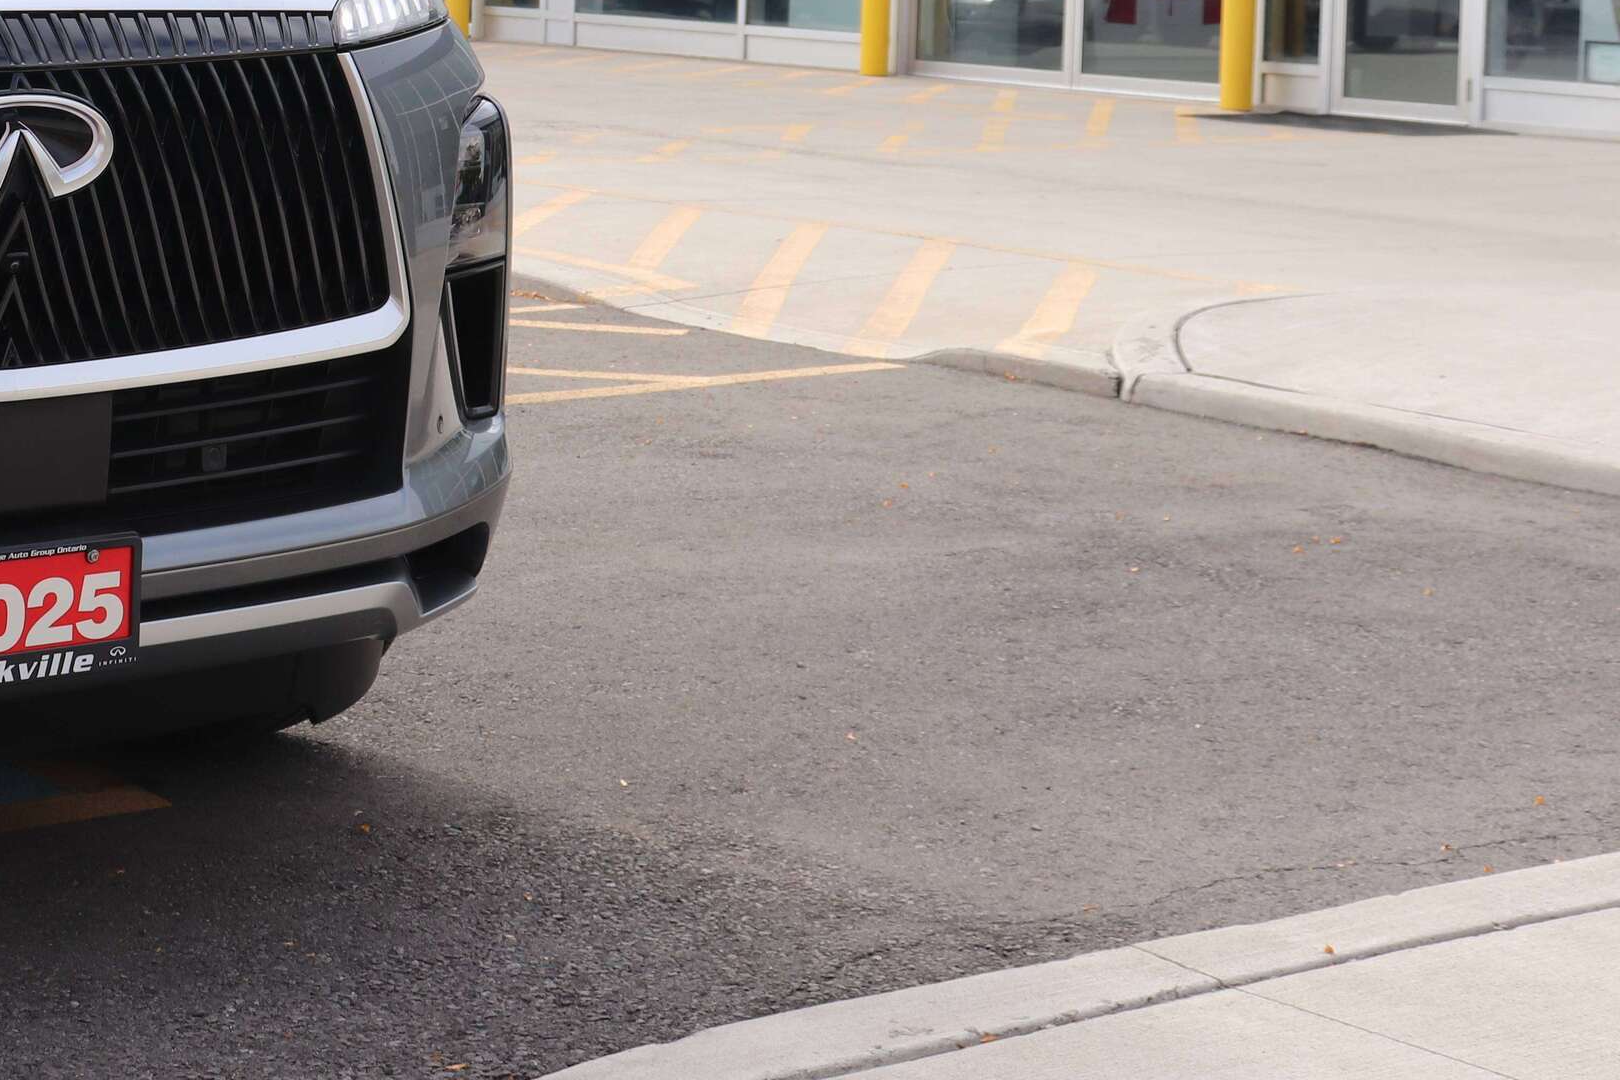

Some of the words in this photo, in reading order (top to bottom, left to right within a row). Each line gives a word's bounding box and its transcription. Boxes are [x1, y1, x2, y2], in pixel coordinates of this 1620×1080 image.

[8, 550, 29, 560] Auto
[30, 547, 55, 558] Group
[56, 544, 87, 555] Ontario
[99, 656, 137, 667] INFINITI
